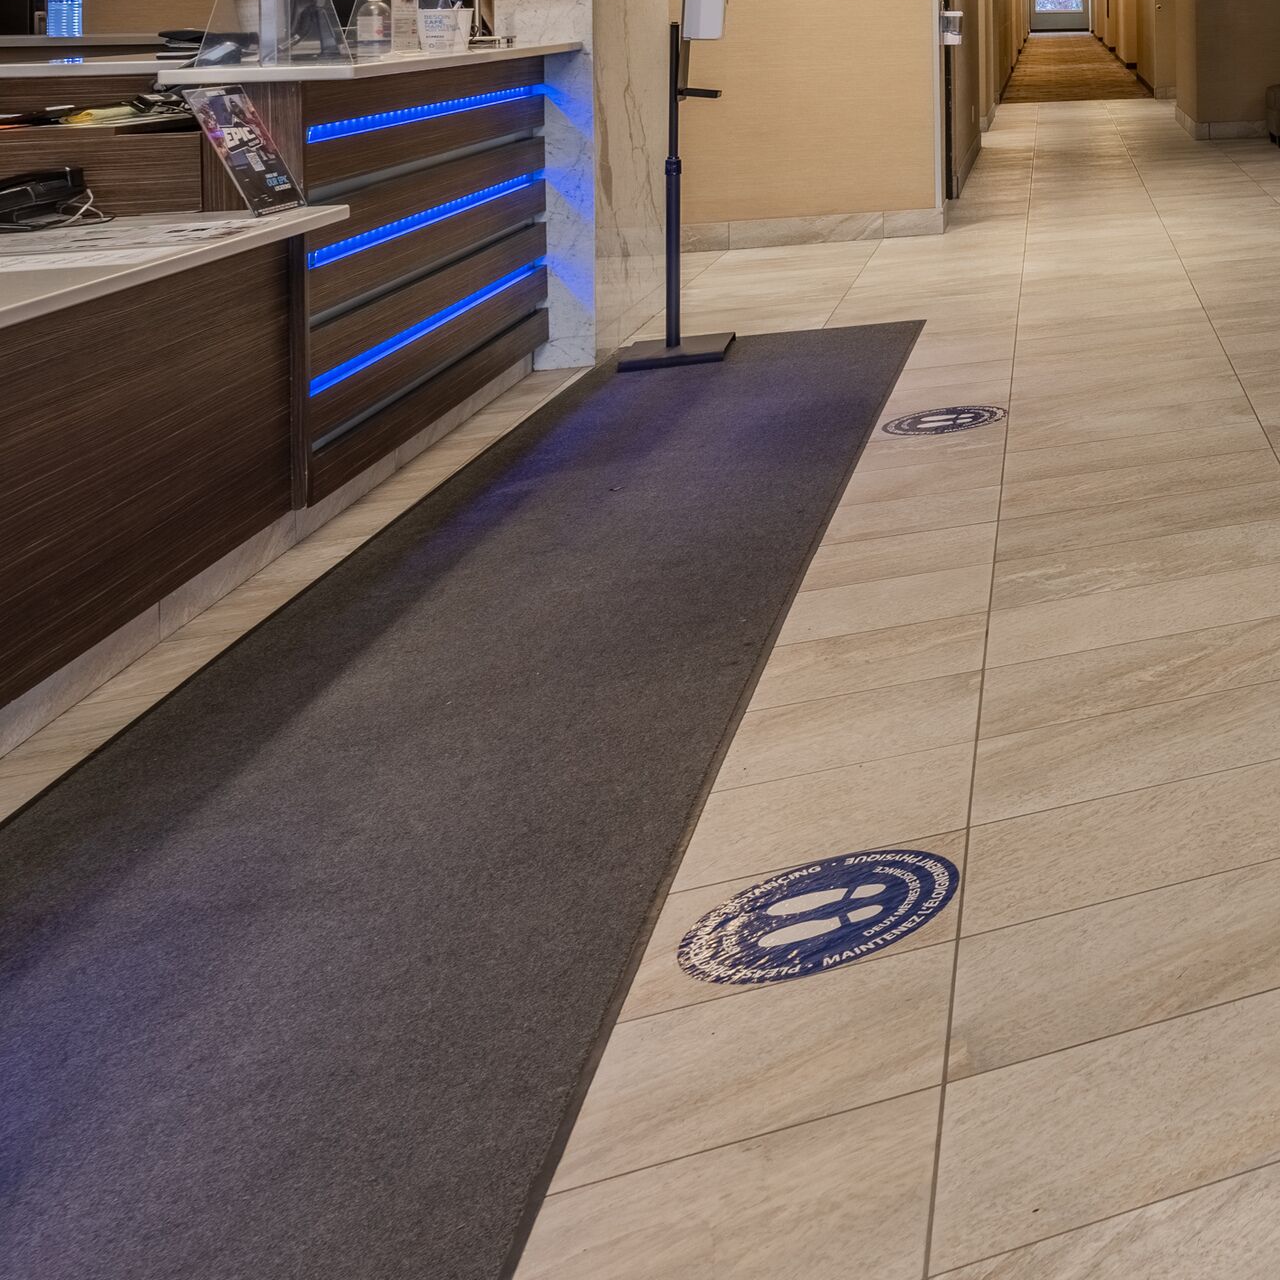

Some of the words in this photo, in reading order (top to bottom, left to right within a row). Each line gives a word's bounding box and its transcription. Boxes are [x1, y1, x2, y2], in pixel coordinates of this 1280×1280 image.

[222, 127, 258, 149] EPIC
[843, 853, 922, 866] PHYSIQUE
[862, 915, 899, 937] DEUX
[822, 915, 926, 967] MAINTENEZ
